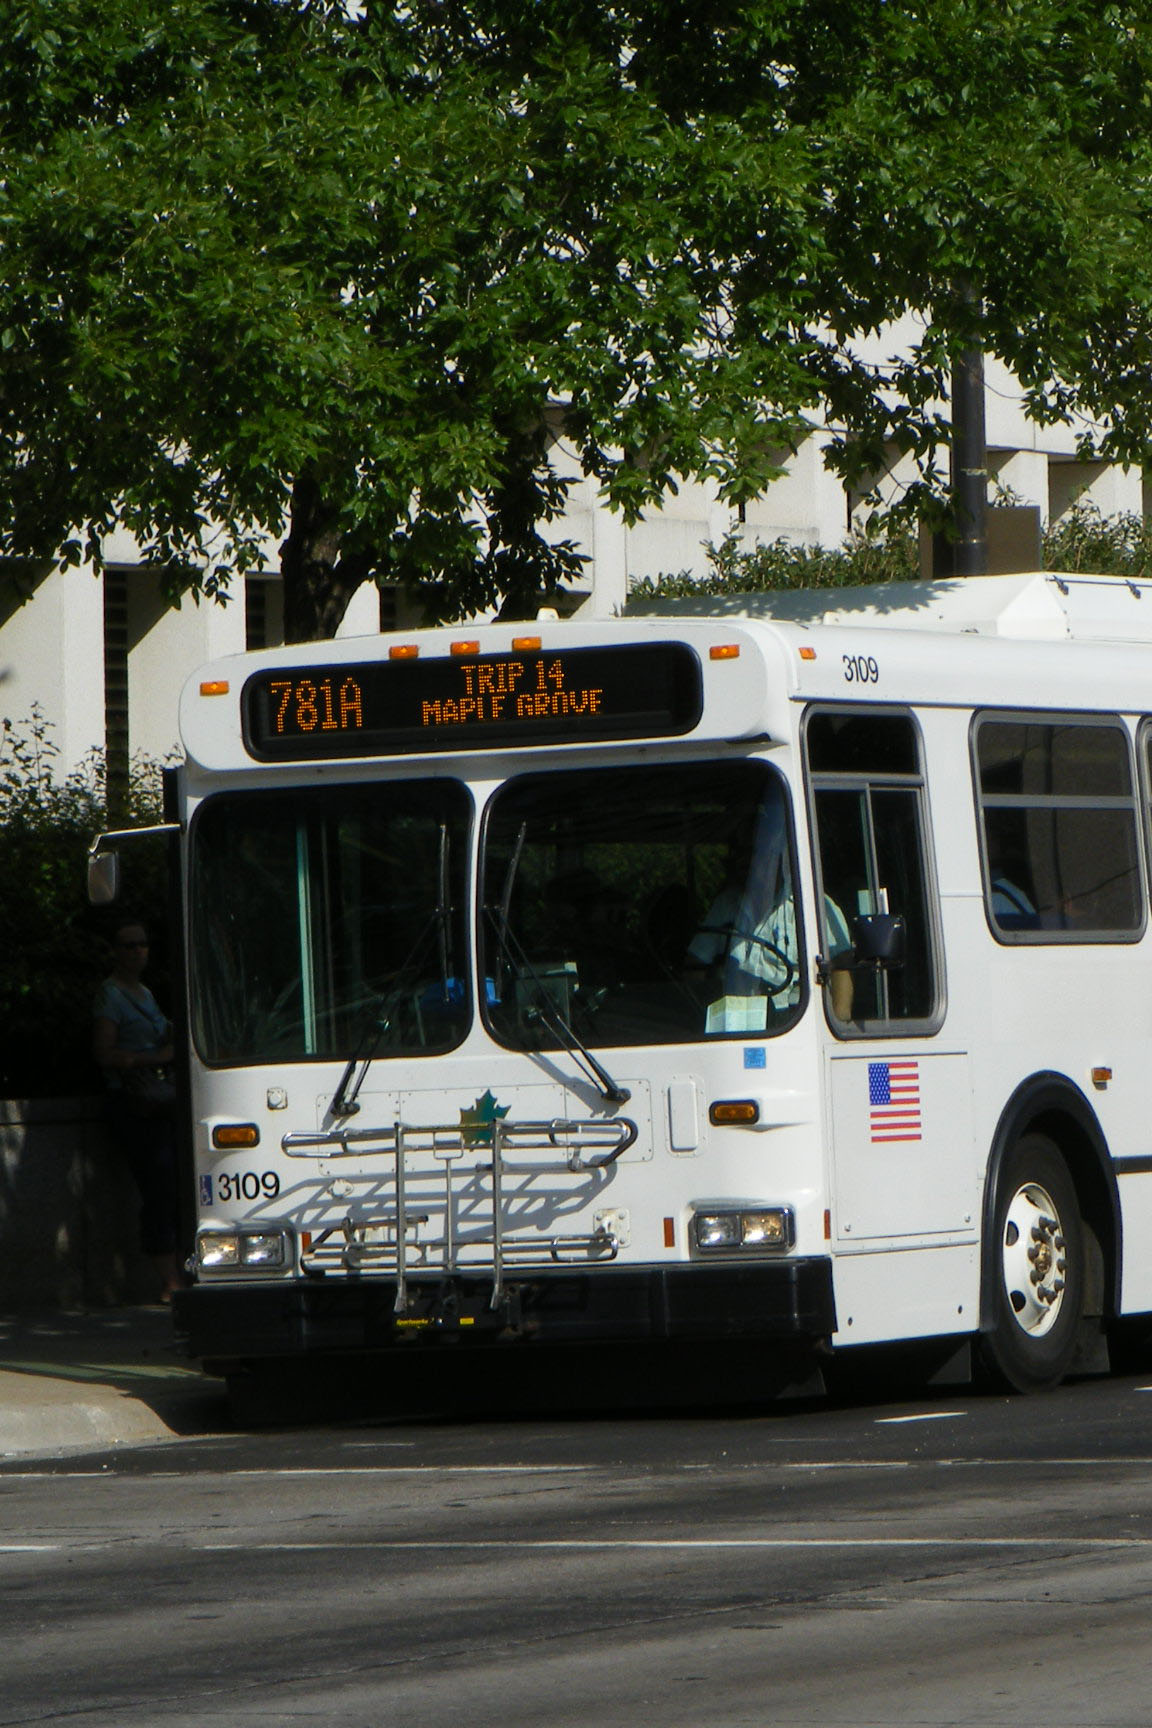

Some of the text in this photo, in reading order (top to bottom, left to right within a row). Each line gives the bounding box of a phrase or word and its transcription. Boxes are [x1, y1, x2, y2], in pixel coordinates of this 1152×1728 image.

[460, 659, 565, 695] TRIP 14
[842, 654, 879, 684] 3109
[270, 678, 363, 733] 781A
[218, 1171, 281, 1201] 3109
